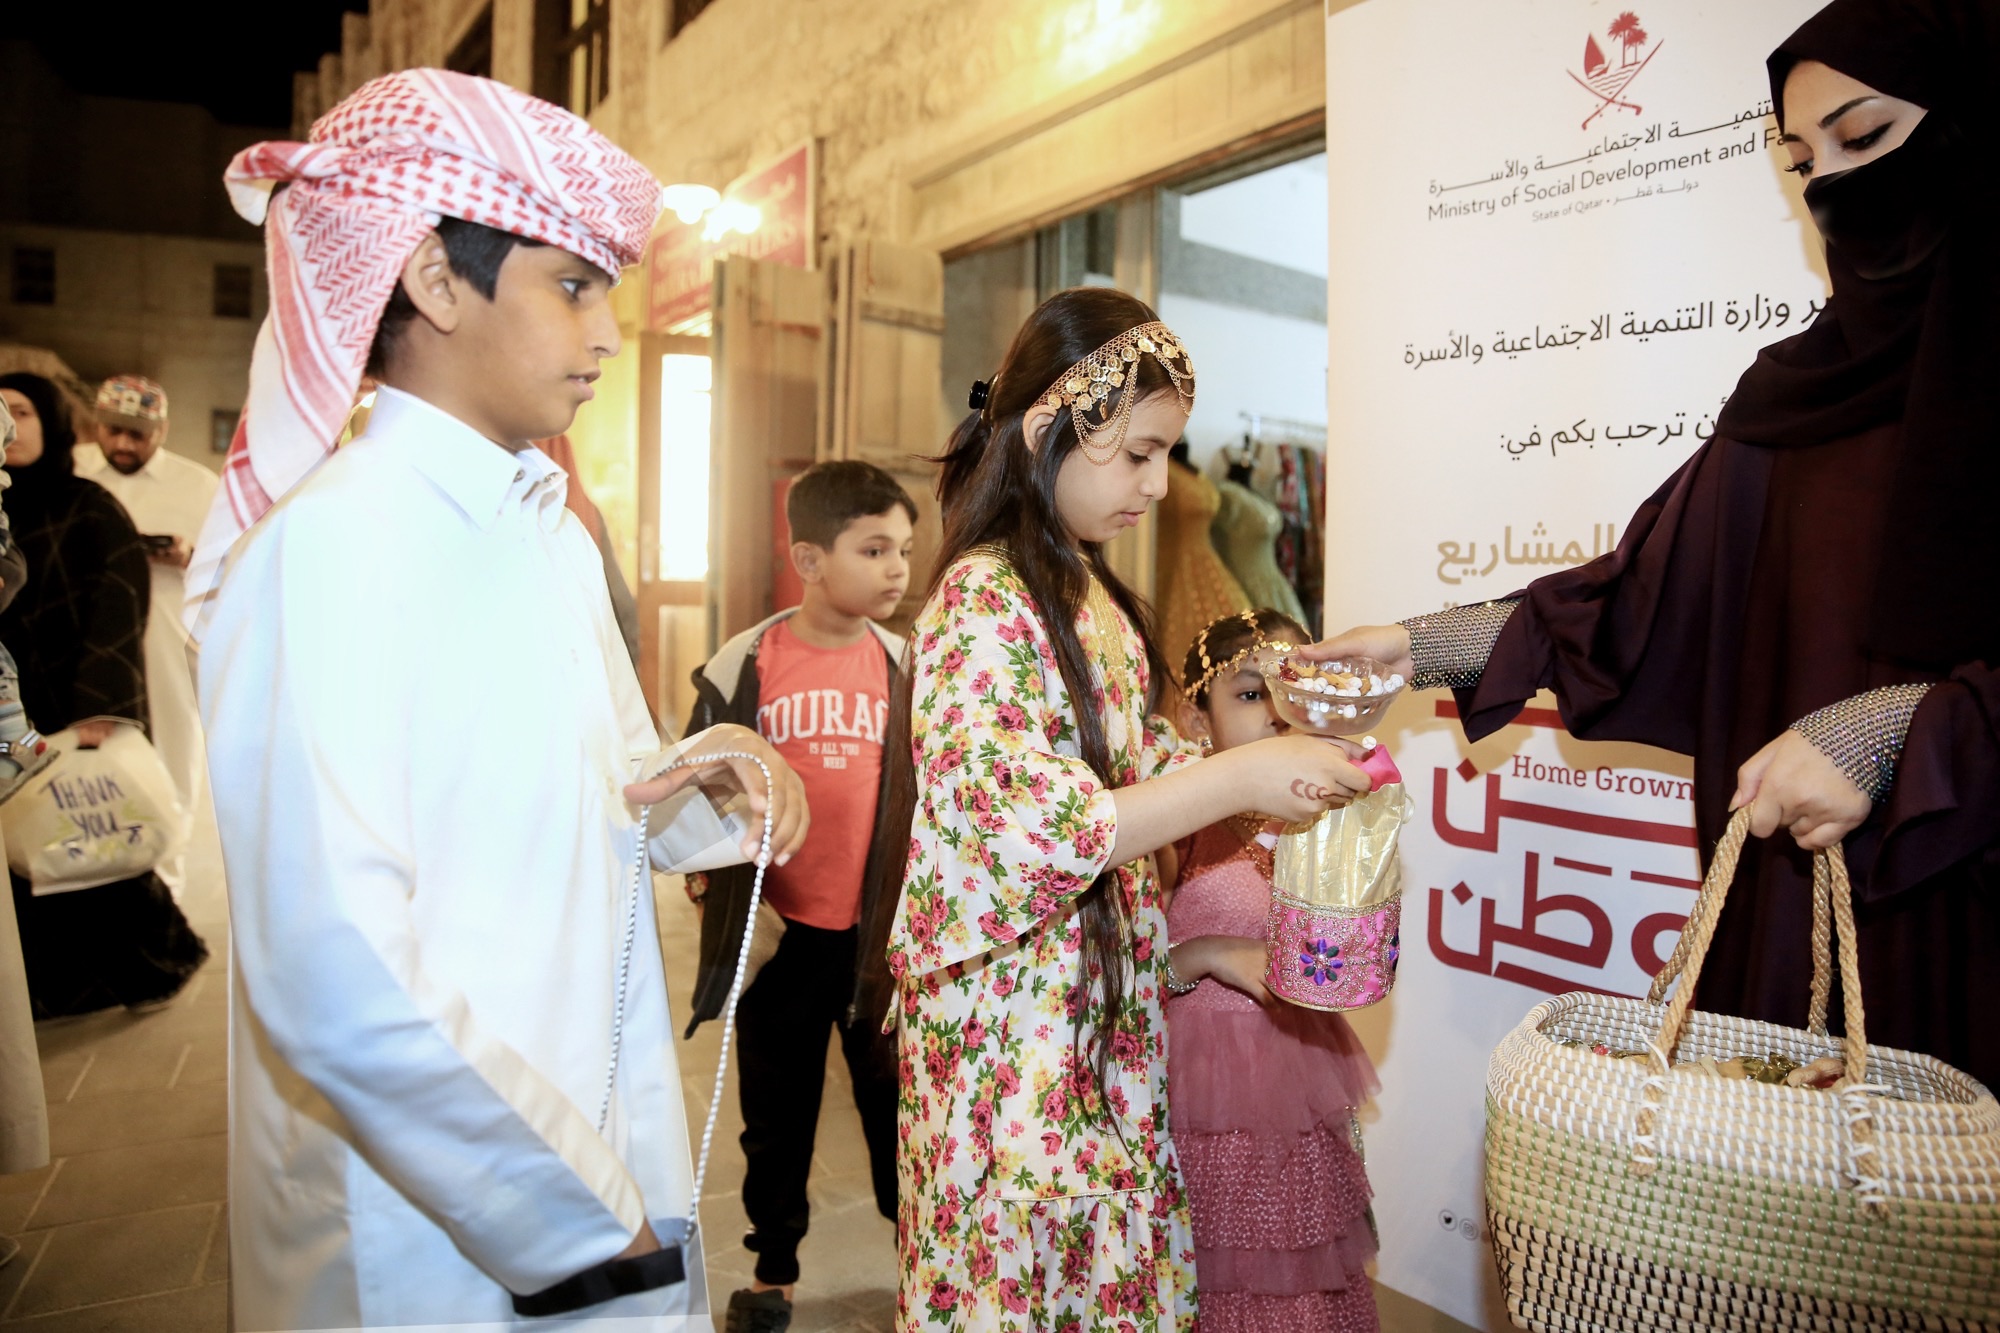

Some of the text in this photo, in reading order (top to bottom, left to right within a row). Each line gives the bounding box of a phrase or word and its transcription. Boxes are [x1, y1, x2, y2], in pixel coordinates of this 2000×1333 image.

[1428, 199, 1496, 221] Ministry
[1501, 186, 1520, 207] of
[1524, 174, 1575, 202] Social
[1581, 149, 1711, 189] Development
[1718, 132, 1755, 160] and
[1532, 199, 1603, 222] State of Qatar
[1620, 301, 1713, 343] التنمية
[1725, 293, 1790, 332] وزارة
[1404, 329, 1484, 370] والأسرة
[1492, 313, 1610, 360] الاجتماعية
[1551, 418, 1595, 457] بكم
[1605, 412, 1686, 447] ترحب
[1437, 521, 1615, 585] المشاريع
[821, 742, 838, 755] ALL
[840, 742, 860, 756] YOU
[823, 756, 847, 769] NEED
[39, 771, 125, 810] THANK
[1512, 754, 1694, 800] Home Grown
[71, 812, 119, 841] YOU
